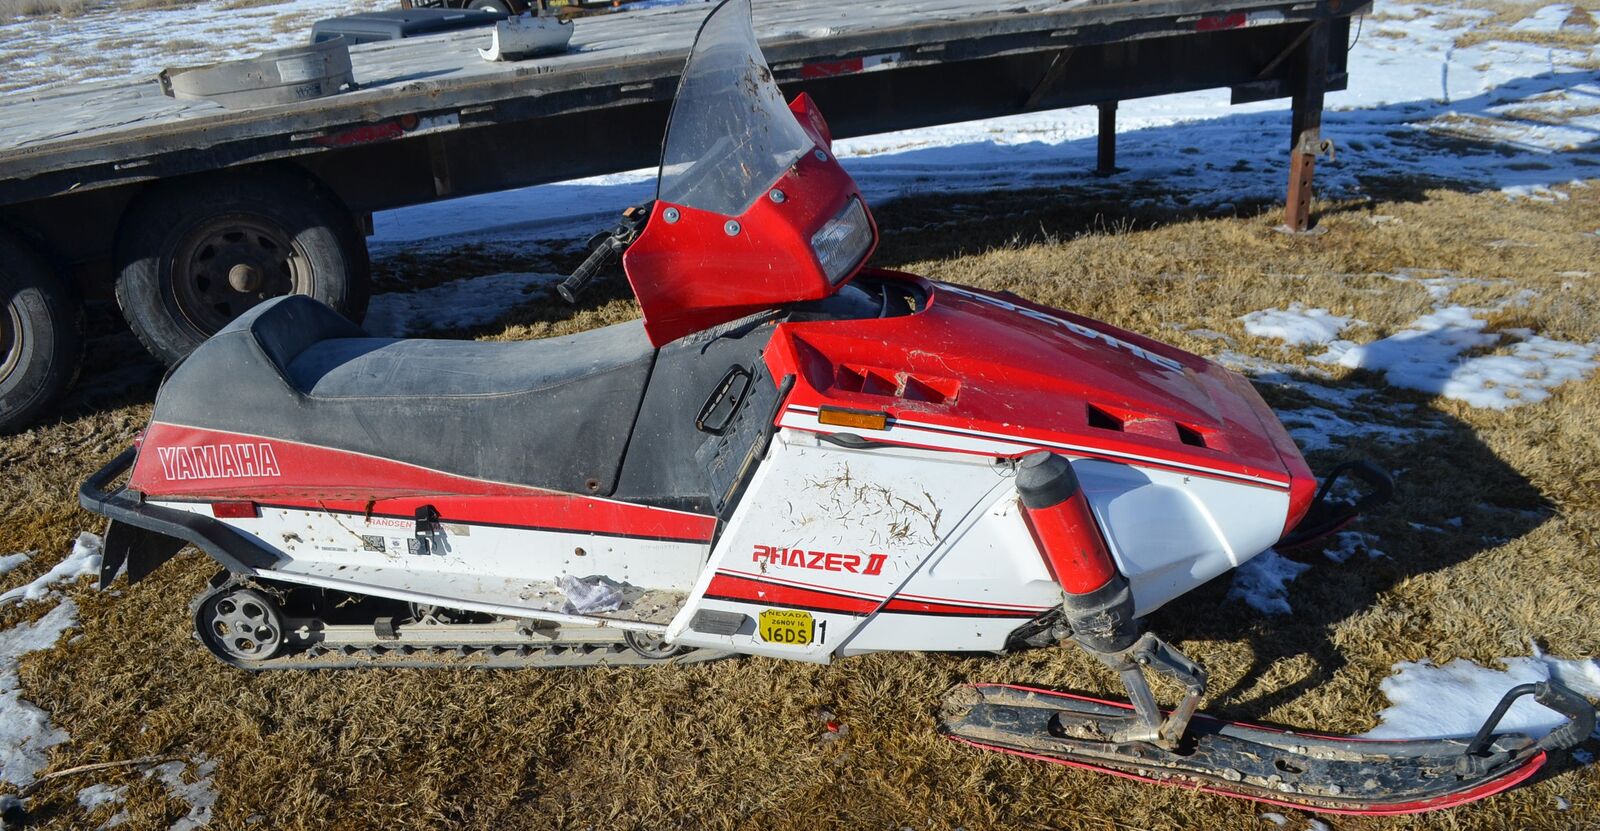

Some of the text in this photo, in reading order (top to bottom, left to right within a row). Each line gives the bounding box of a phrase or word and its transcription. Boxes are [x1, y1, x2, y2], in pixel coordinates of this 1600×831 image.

[157, 443, 281, 480] YAMAHA
[364, 518, 413, 529] RANDSEN
[752, 544, 888, 576] PHAZER II
[768, 611, 809, 619] NEVADA
[767, 627, 807, 644] 16DS
